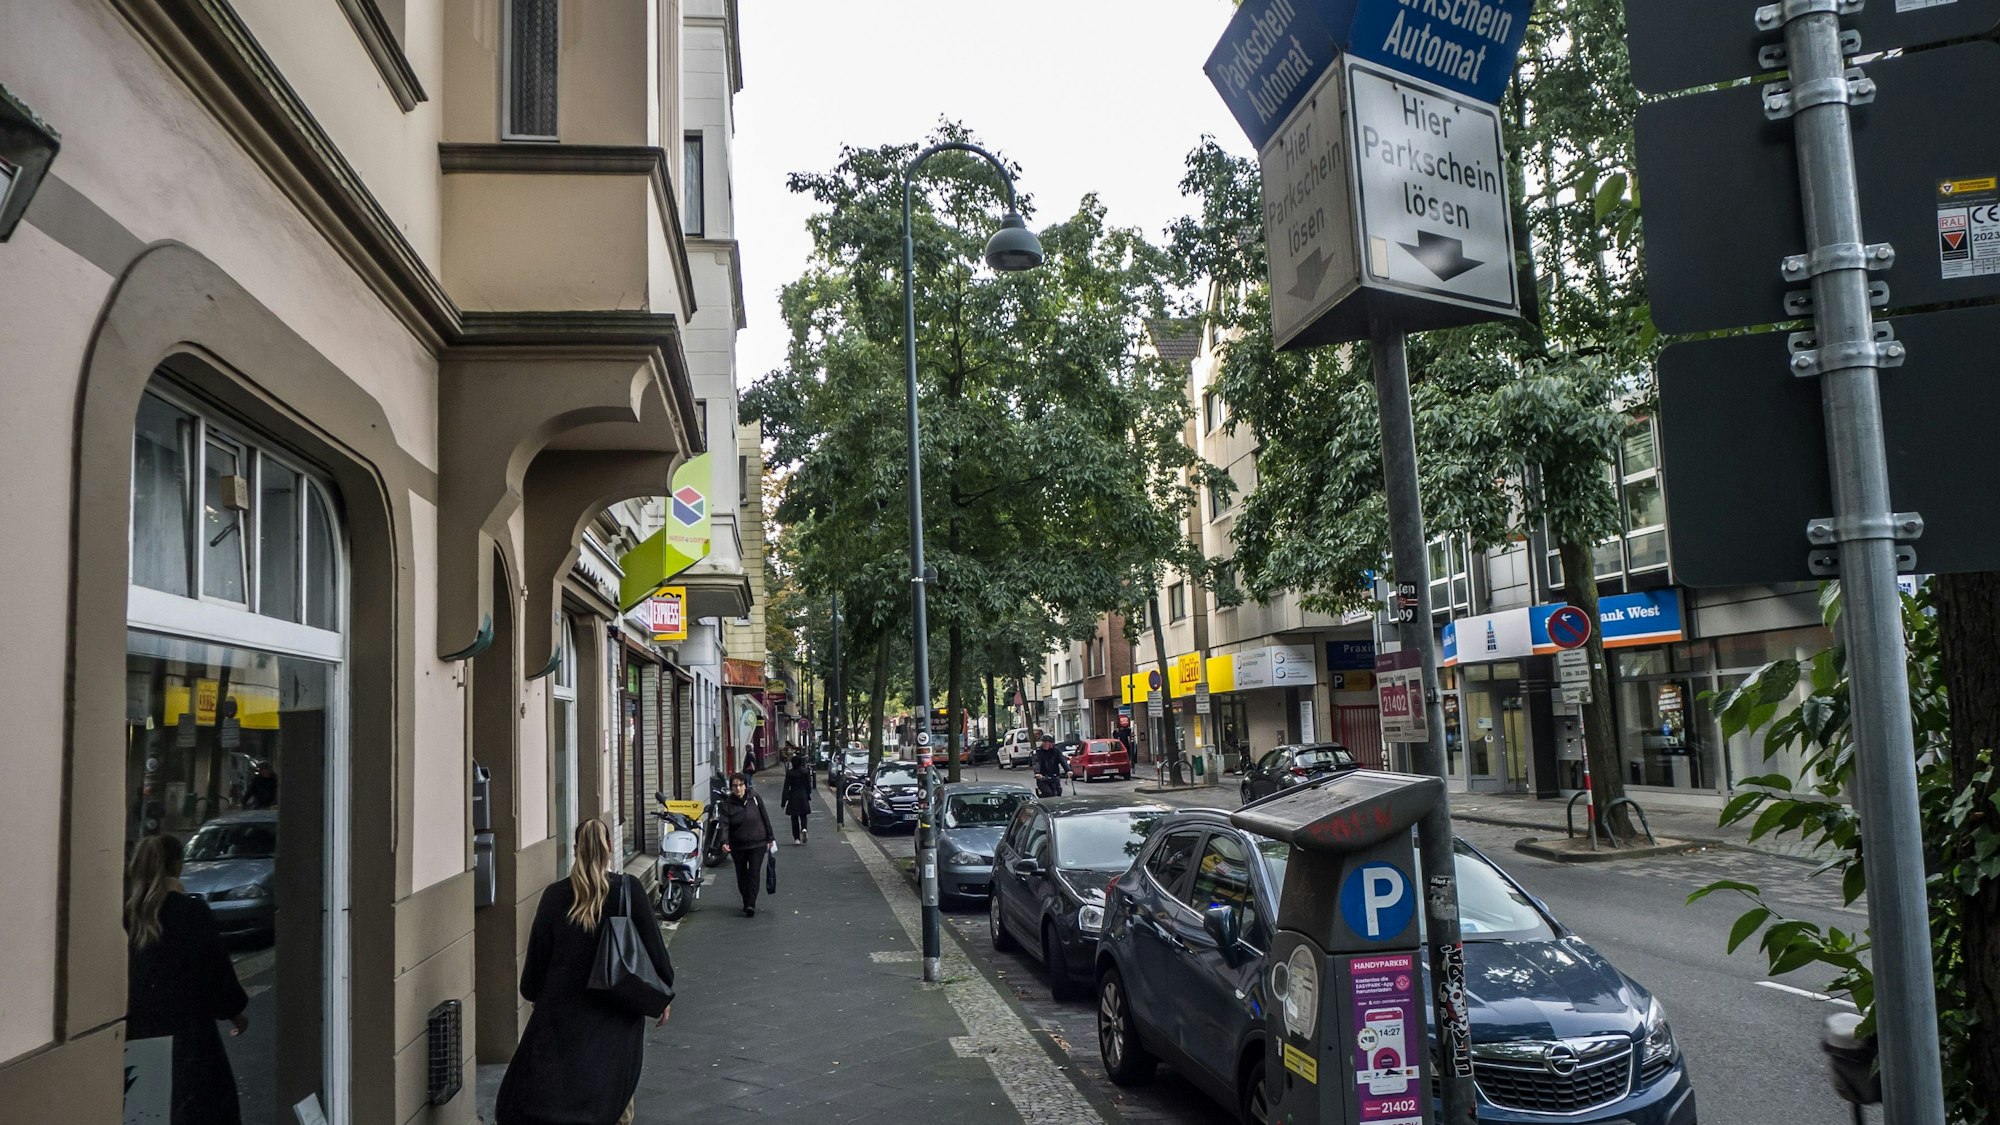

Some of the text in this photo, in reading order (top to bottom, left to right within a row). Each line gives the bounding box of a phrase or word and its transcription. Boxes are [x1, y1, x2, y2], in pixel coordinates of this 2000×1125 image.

[1397, 0, 1513, 44] kschein
[1217, 0, 1296, 98] Parkschein
[1382, 9, 1487, 85] Automat
[1247, 34, 1314, 125] Automat
[1401, 94, 1452, 138] Hier
[1282, 121, 1312, 171] Hier
[1362, 126, 1497, 195] Parkschein
[1269, 140, 1341, 230] Parkschein
[1404, 182, 1470, 229] lösen
[1288, 206, 1325, 257] lösen
[1941, 217, 1964, 227] RAL
[1974, 231, 2000, 242] 2023
[653, 603, 679, 626] EXPRESS
[1600, 604, 1660, 623] ank West
[1179, 660, 1200, 683] Netto
[1333, 675, 1343, 688] P
[1382, 694, 1407, 712] 21402
[1363, 867, 1404, 936] P
[1353, 959, 1409, 970] HANDYPARKEN
[1379, 1027, 1401, 1037] 14:27
[1381, 1099, 1416, 1114] 21402
